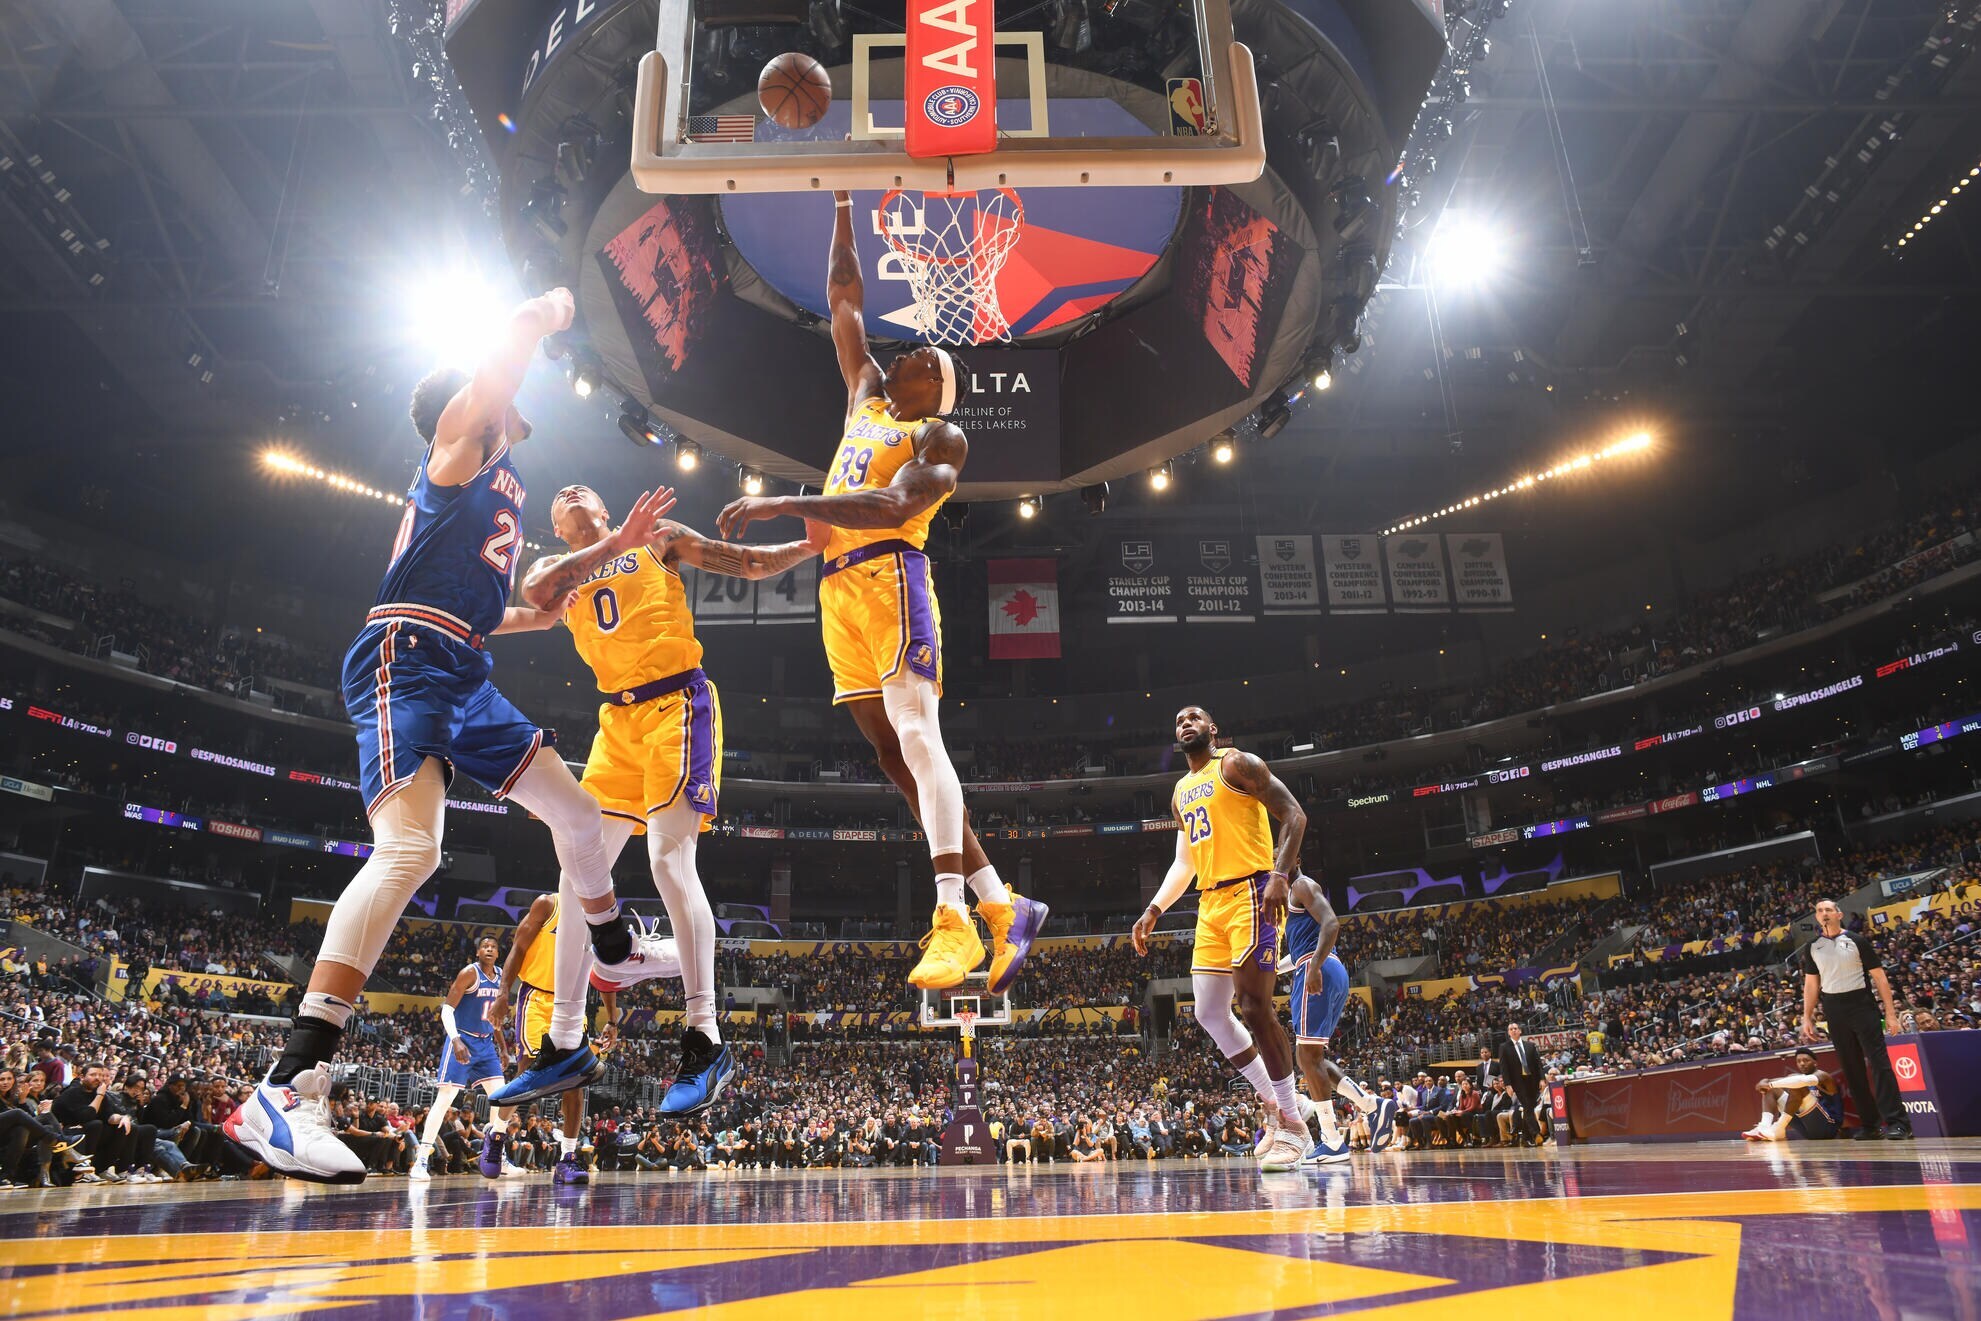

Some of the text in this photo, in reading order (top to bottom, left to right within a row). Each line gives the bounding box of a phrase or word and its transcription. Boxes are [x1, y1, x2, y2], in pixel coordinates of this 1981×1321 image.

[971, 372, 1032, 393] LTA
[952, 406, 1013, 417] AIRLINE OF
[846, 414, 908, 448] LAKERS
[986, 420, 1027, 430] LAKERS
[829, 444, 874, 492] 39
[489, 466, 527, 509] NEW
[1268, 563, 1306, 572] WESTERN
[1334, 562, 1372, 571] WESTERN
[1108, 575, 1171, 587] STANLEY CUP
[1187, 576, 1248, 586] STANLEY CUP
[1263, 571, 1313, 581] CONFERENCE
[1328, 570, 1379, 580] CONFERENCE
[775, 570, 797, 603] 4
[1266, 580, 1312, 589] CHAMPIONS
[1332, 579, 1378, 588] CHAMPIONS
[1109, 585, 1172, 597] CHAMPIONS
[1187, 585, 1249, 596] CHAMPIONS
[1273, 591, 1308, 601] 2013-14
[1340, 590, 1373, 600] 2011-12
[592, 586, 622, 635] 0
[1118, 599, 1165, 612] 2013-14
[1199, 599, 1242, 612] 2011-12
[1774, 674, 1864, 711] @ESPNLOSANGELES
[1962, 721, 1981, 733] NHL
[1900, 731, 1919, 744] MON
[1902, 740, 1919, 751] DET
[190, 747, 276, 777] @ESPNLOSANGELES
[1541, 746, 1622, 773] @ESPNLOSANGELES
[1755, 779, 1773, 790] NHL
[1179, 780, 1214, 813] LAKERS
[1347, 793, 1389, 808] Spectrum
[182, 820, 198, 831] NHL
[1142, 821, 1180, 831] TOSHIB
[1183, 805, 1212, 844] 23
[1575, 820, 1590, 830] NHL
[210, 821, 260, 841] TOSHIBA
[798, 830, 830, 839] DELTA
[833, 830, 876, 841] STAPLES
[1007, 830, 1019, 839] 30
[271, 834, 310, 847] BUD LIGHT
[1473, 832, 1517, 849] STAPLES
[1892, 880, 1911, 890] UCLA
[1902, 1100, 1937, 1114] YOTA
